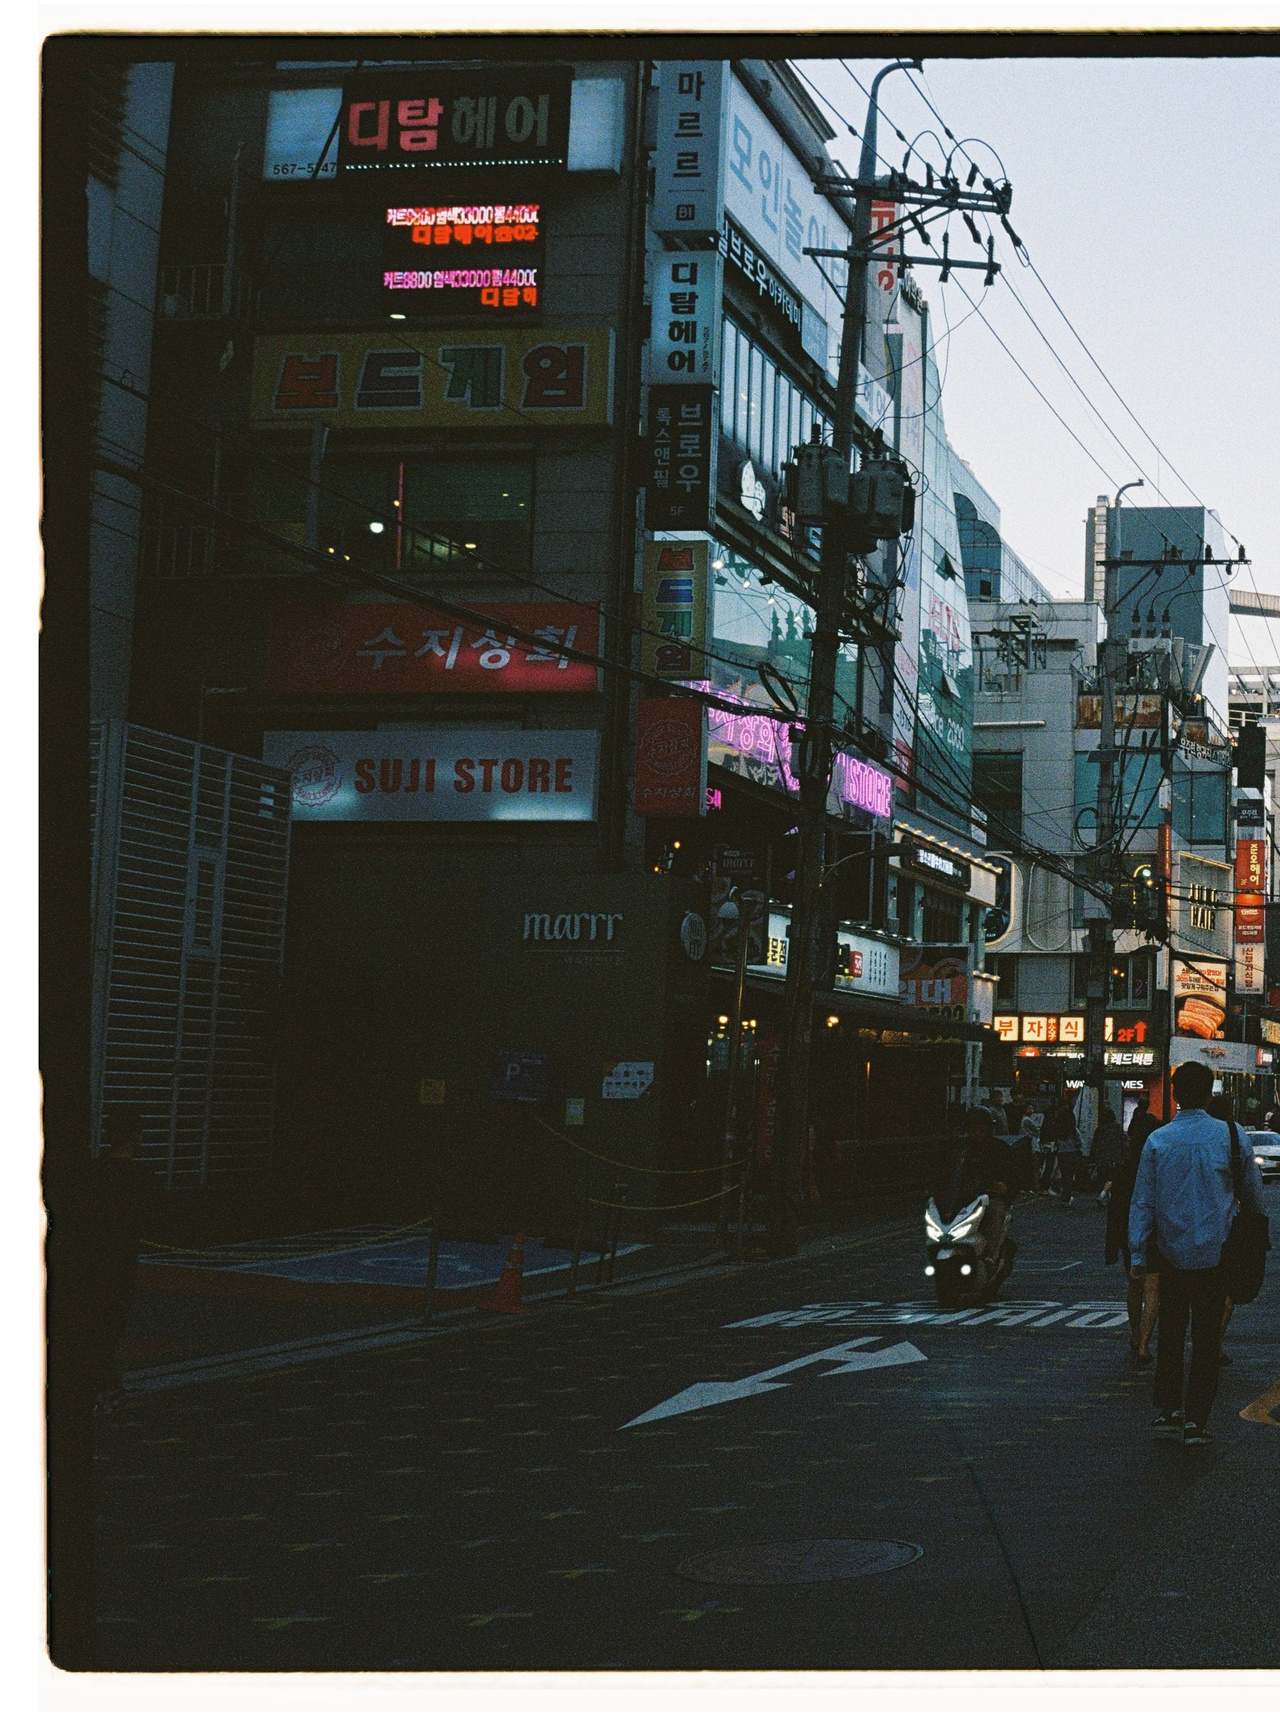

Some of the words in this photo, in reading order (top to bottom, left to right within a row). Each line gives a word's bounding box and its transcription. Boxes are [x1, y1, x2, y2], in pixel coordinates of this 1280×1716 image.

[347, 94, 550, 152] 디탐헤어
[673, 71, 705, 178] 마르르
[273, 162, 337, 175] 567-547
[729, 113, 848, 290] 모인놀이
[666, 262, 698, 373] 디탐헤어
[272, 341, 588, 411] 보드게임
[676, 404, 703, 493] 브로우
[356, 625, 578, 670] 수지상회
[355, 757, 436, 794] SUJI
[453, 757, 574, 793] STORE
[849, 759, 891, 818] STORE
[522, 912, 624, 941] marrr
[1190, 906, 1216, 931] HAIR
[1111, 1053, 1154, 1066] 레드버튼
[1117, 1029, 1134, 1042] 2F
